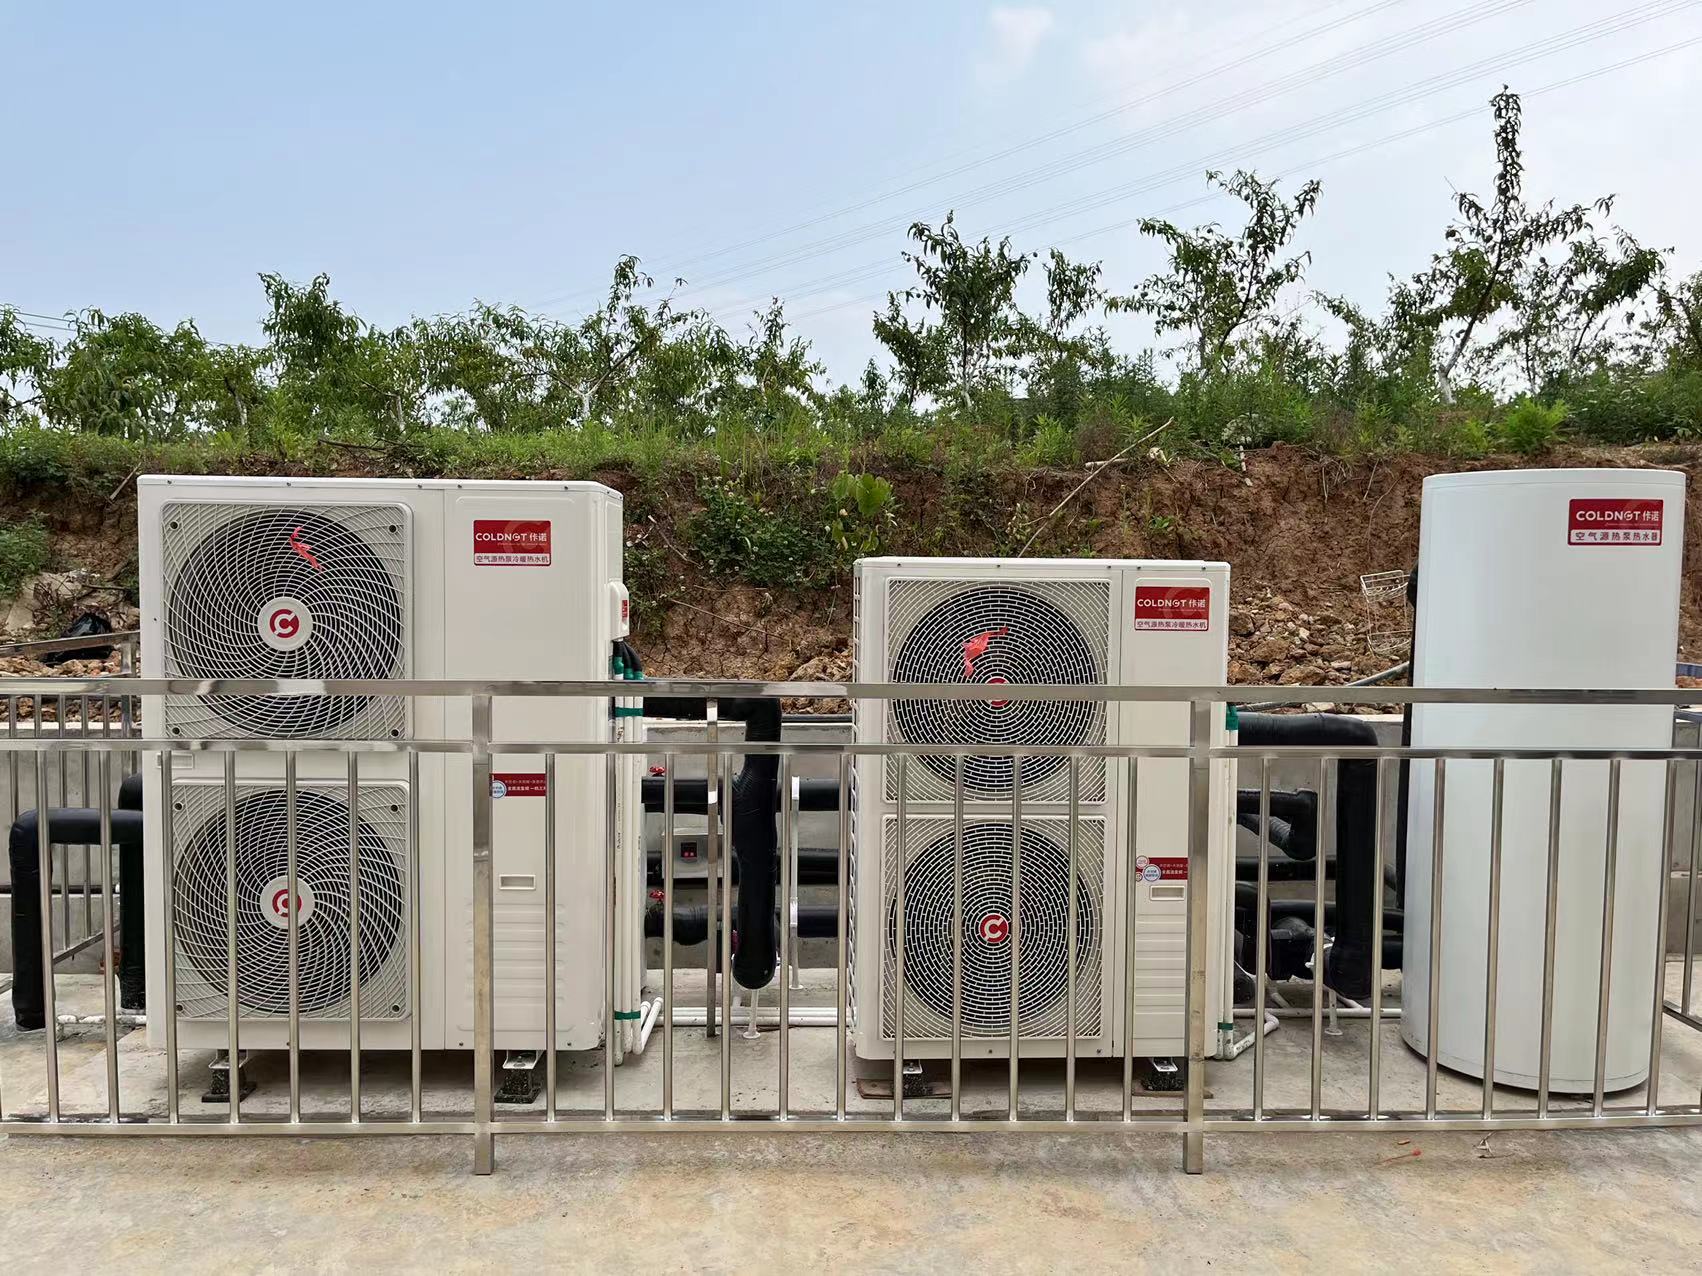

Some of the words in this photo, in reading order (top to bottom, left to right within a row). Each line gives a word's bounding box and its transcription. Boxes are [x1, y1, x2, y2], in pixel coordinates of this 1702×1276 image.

[1575, 532, 1658, 541] 空气源热泵热水器
